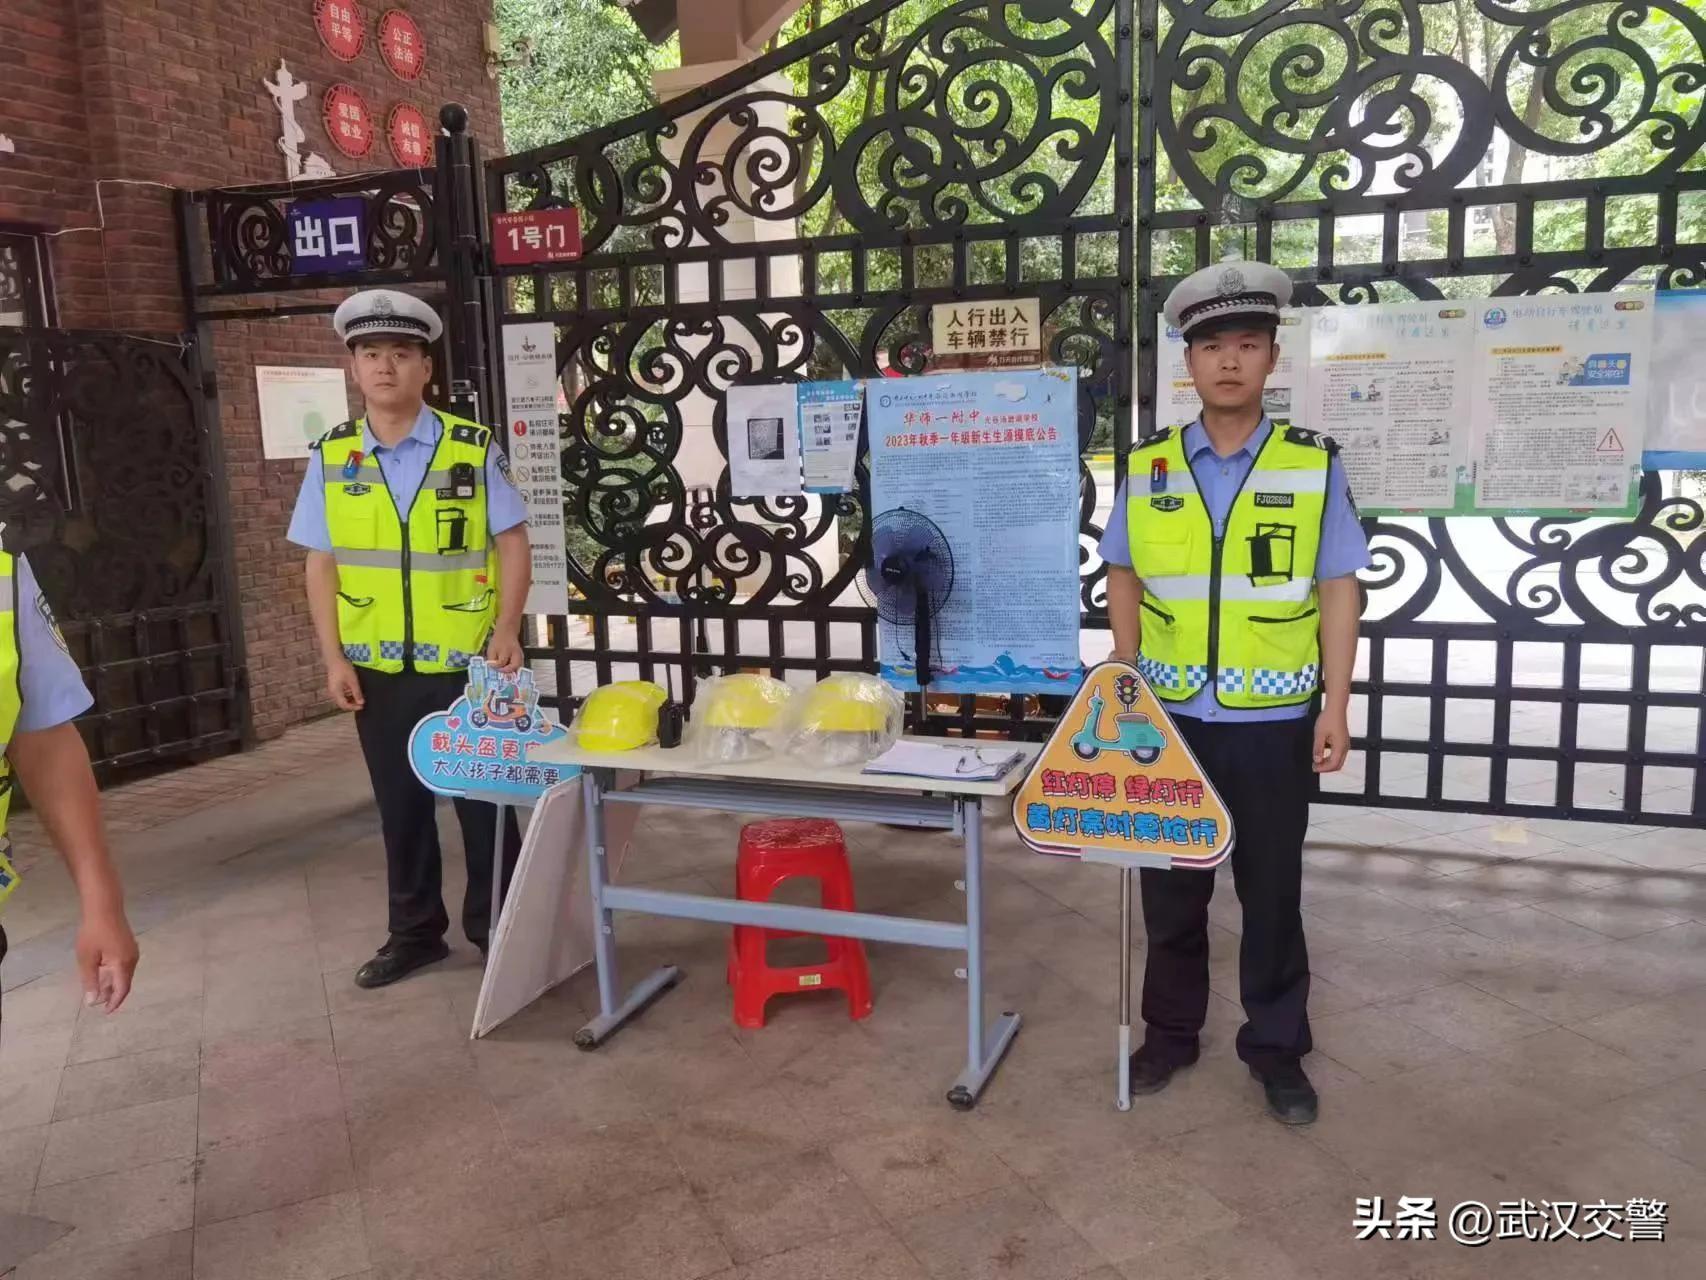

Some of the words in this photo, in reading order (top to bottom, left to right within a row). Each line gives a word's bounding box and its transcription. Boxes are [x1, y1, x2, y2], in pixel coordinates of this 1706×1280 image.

[330, 3, 351, 24] 自由
[393, 27, 413, 46] 公正
[295, 216, 361, 257] 出口
[507, 224, 565, 251] 1号门
[946, 306, 1029, 328] 人行出入
[946, 327, 1029, 350] 车辆禁行
[903, 409, 980, 427] 华师一附中
[885, 426, 1058, 448] 2023年秋季一年级新生生源摸底公告
[433, 758, 561, 786] 大人孩子都需要
[1041, 768, 1117, 801] 红灯停
[1124, 775, 1204, 807] 绿灯行
[1027, 802, 1218, 847] 黄灯亮时莫抢行
